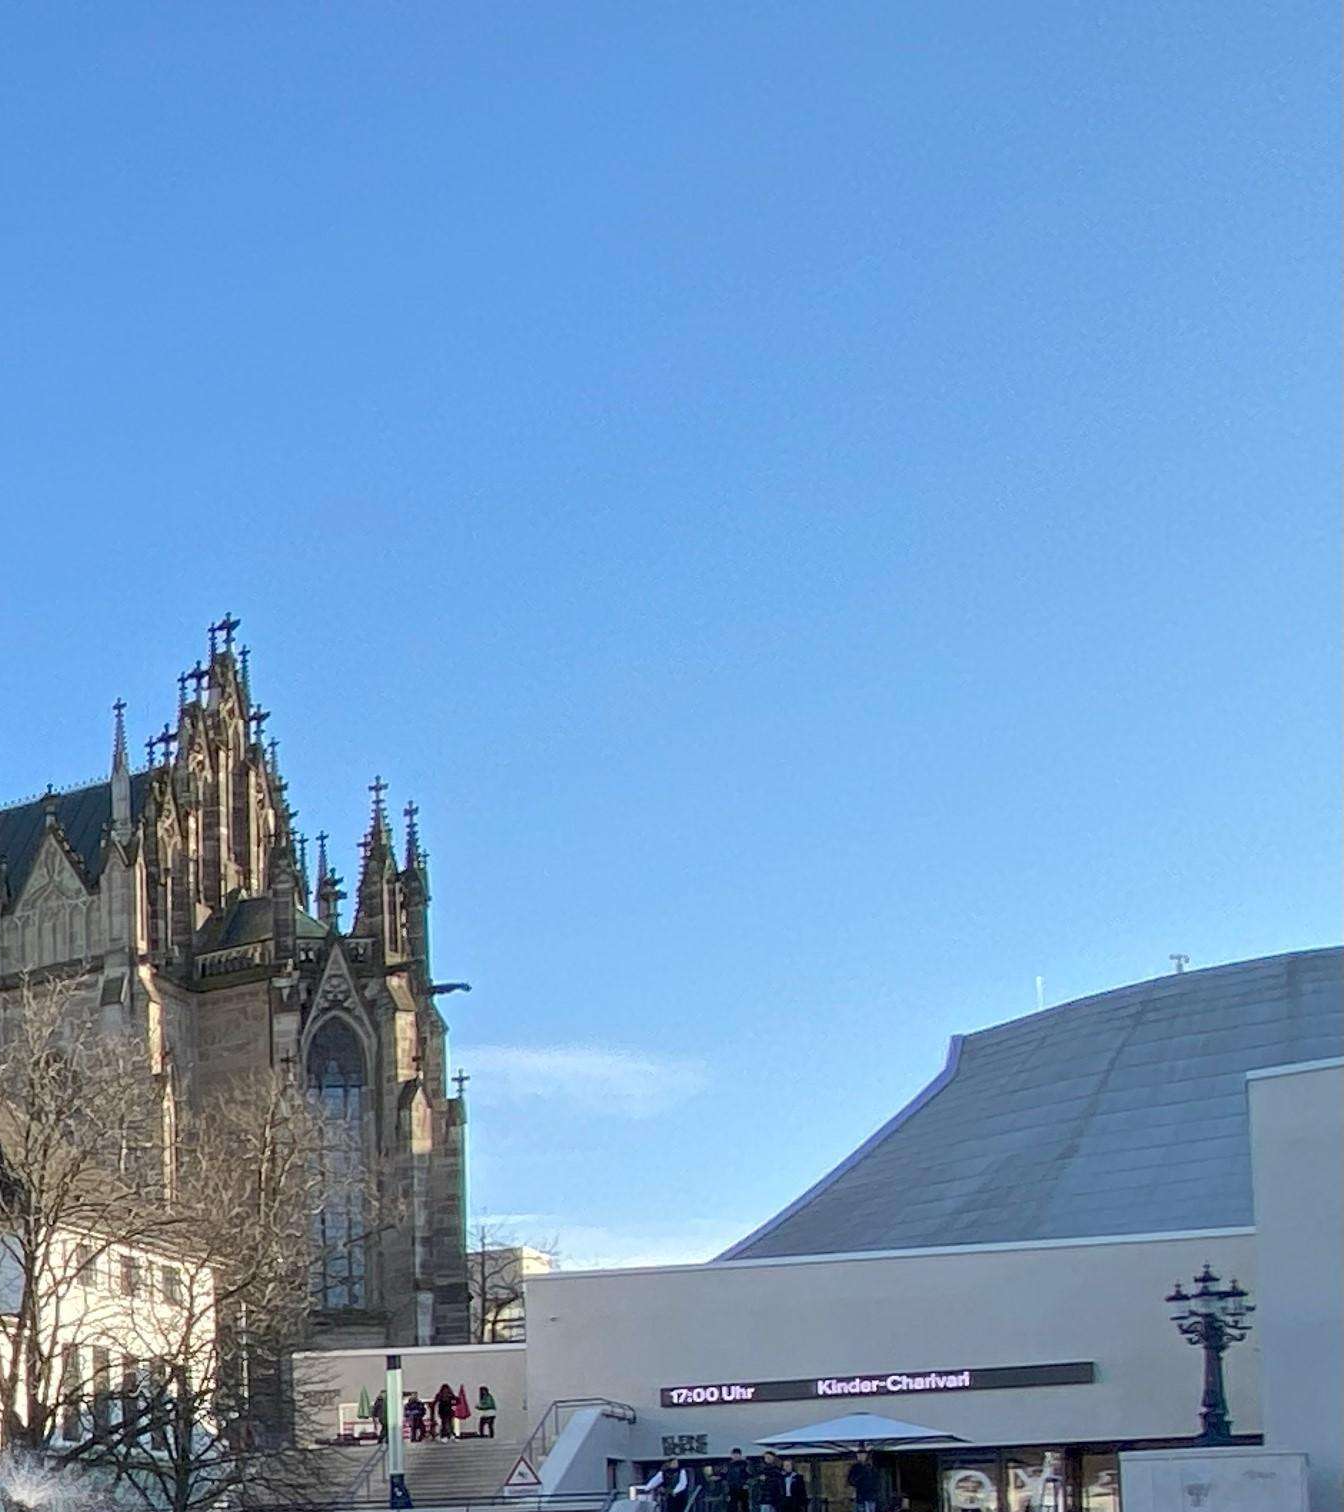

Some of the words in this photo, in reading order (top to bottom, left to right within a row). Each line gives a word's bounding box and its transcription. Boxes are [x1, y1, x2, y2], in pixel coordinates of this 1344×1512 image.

[670, 1387, 719, 1404] 17:00
[721, 1385, 755, 1401] Uhr
[817, 1371, 970, 1394] Kinder-Charivari
